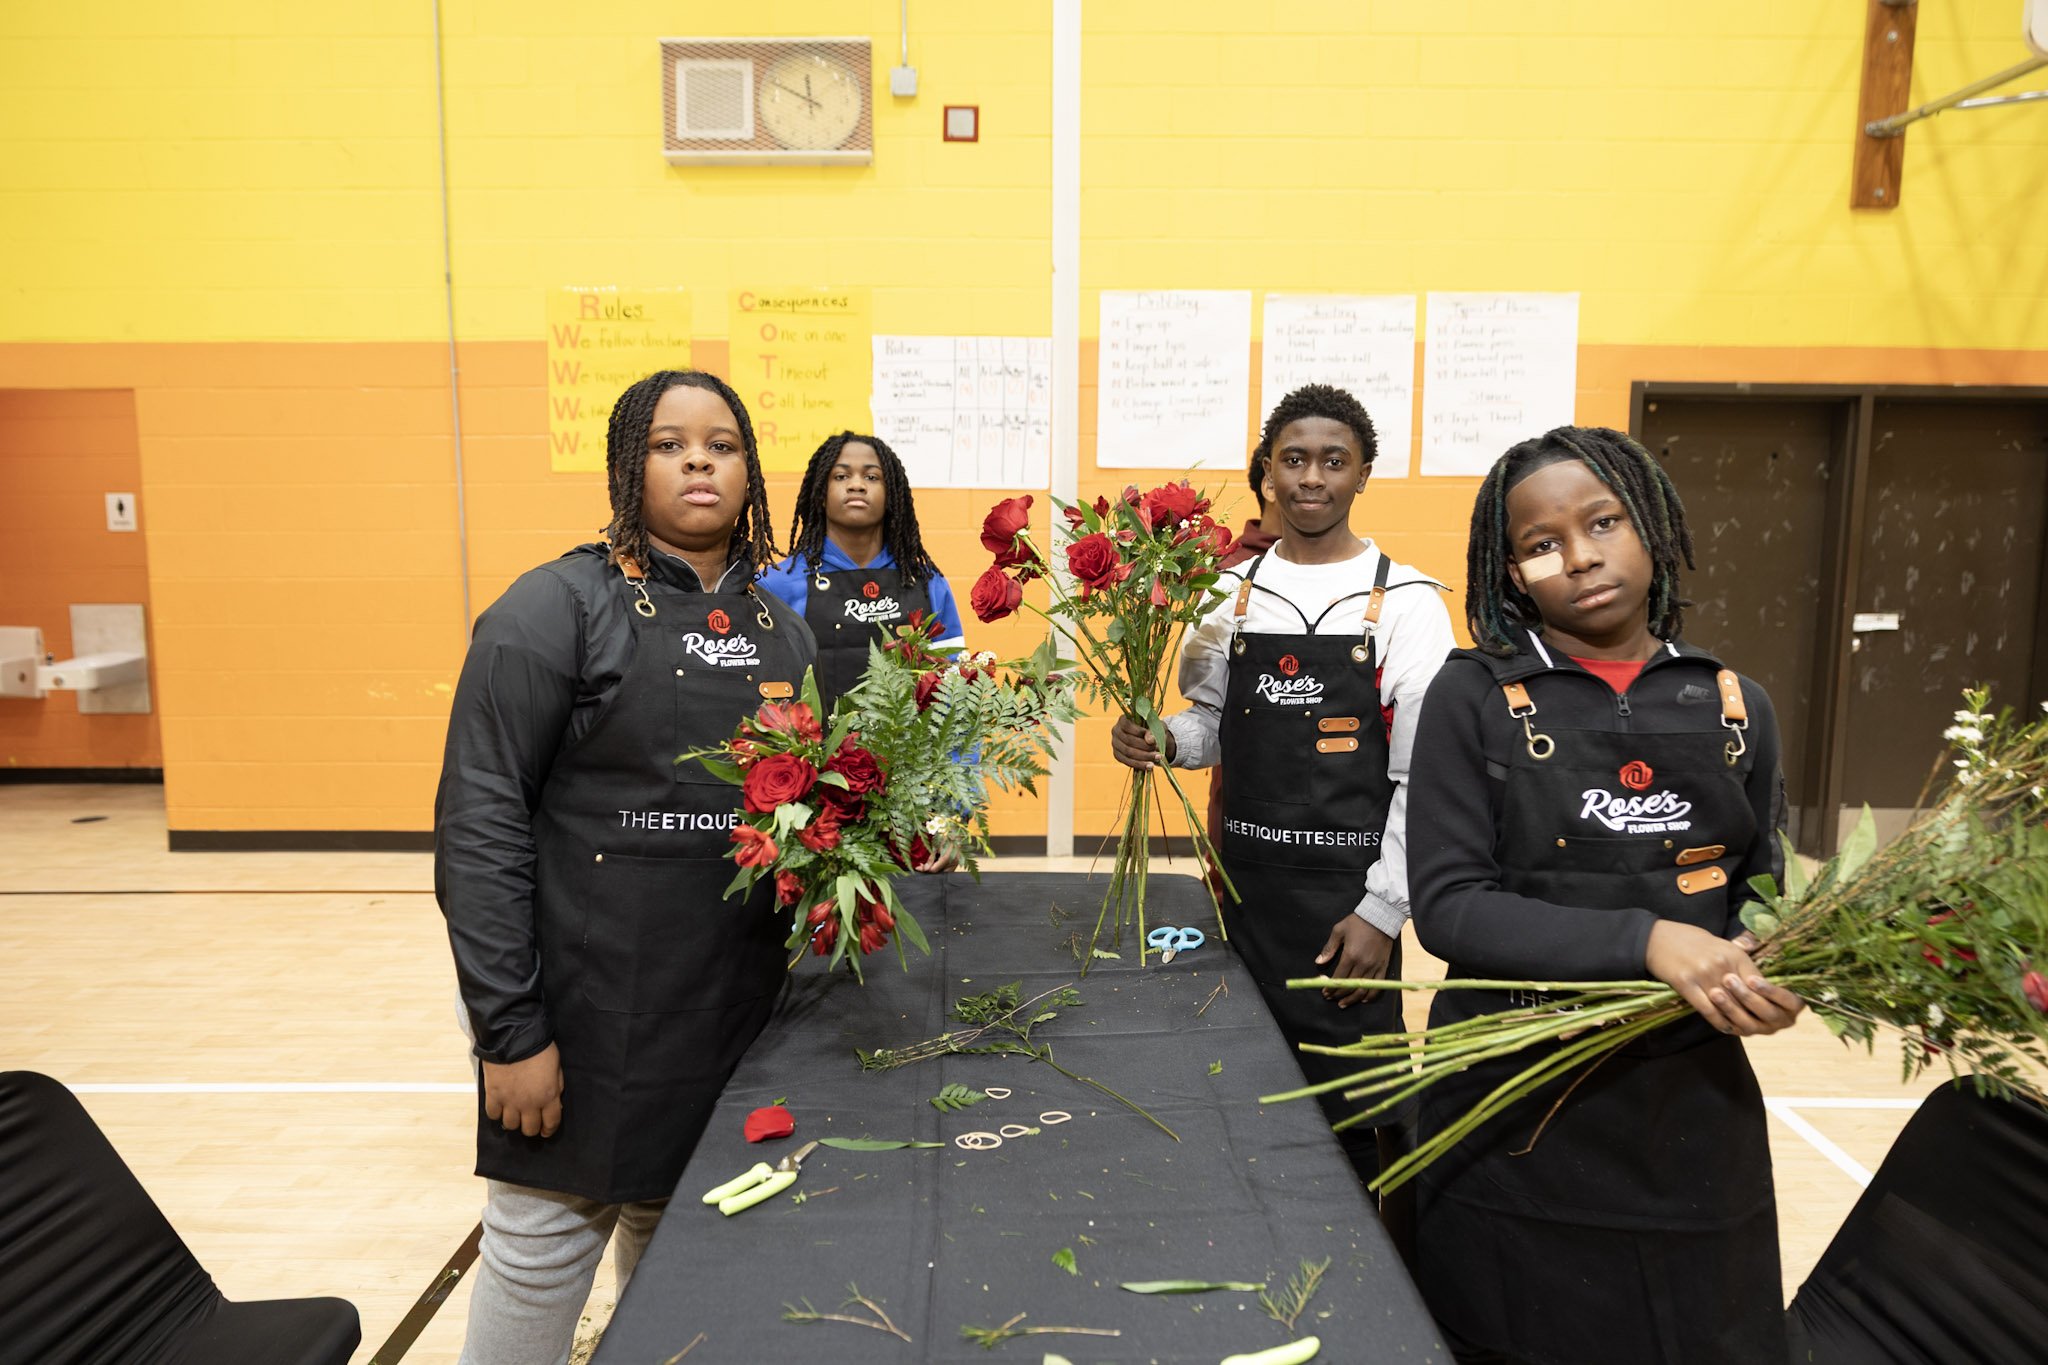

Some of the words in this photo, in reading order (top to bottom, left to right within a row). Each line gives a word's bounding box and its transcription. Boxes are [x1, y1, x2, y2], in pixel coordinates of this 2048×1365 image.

[579, 294, 644, 320] Rules
[552, 324, 590, 349] We
[552, 360, 590, 385] We
[758, 354, 829, 380] Timeout
[758, 391, 795, 409] Call
[844, 596, 900, 622] Rose's
[682, 632, 757, 666] Rose's
[720, 658, 746, 668] FLOWER
[746, 658, 761, 666] SHOP
[1255, 673, 1324, 703] Rose's
[1279, 697, 1305, 706] FLOWER
[1305, 696, 1323, 704] SHOP
[618, 810, 743, 831] THEETIQUE
[1580, 788, 1692, 831] Rose's
[1627, 822, 1666, 834] FLOWER
[1667, 820, 1692, 831] SHOP
